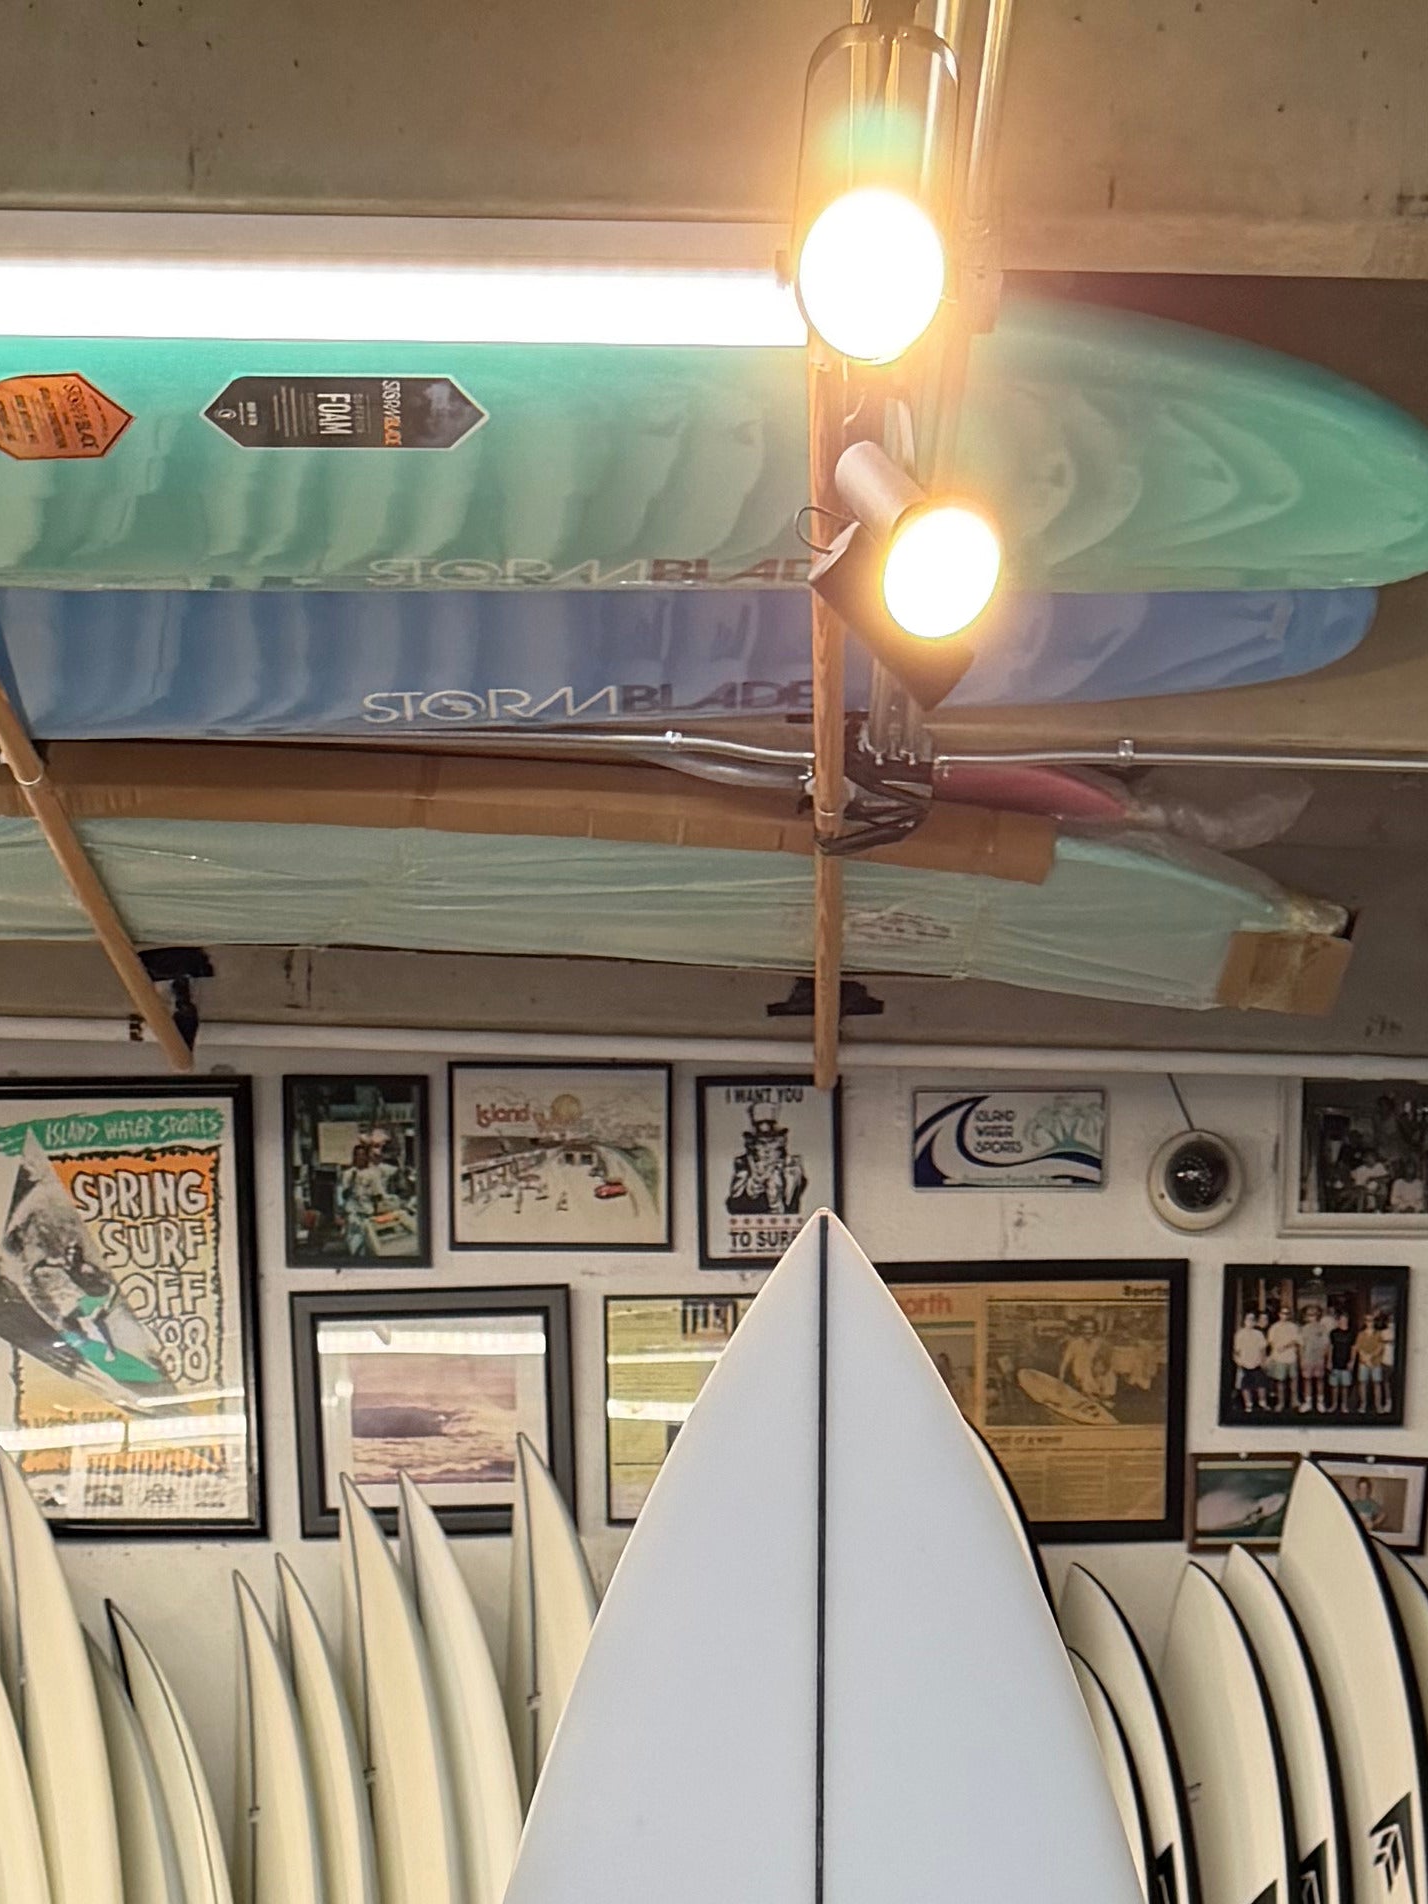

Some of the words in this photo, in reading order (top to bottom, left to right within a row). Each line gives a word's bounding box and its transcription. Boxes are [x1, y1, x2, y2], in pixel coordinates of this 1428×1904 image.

[317, 393, 353, 435] FOAM
[366, 557, 813, 587] STORMBLAD
[734, 1088, 771, 1103] WANT
[777, 1088, 804, 1103] YOU
[72, 1168, 209, 1222] SPRING
[99, 1219, 208, 1269] SURF
[729, 1232, 751, 1247] TO
[118, 1270, 208, 1319] OFF
[905, 1293, 952, 1315] orth
